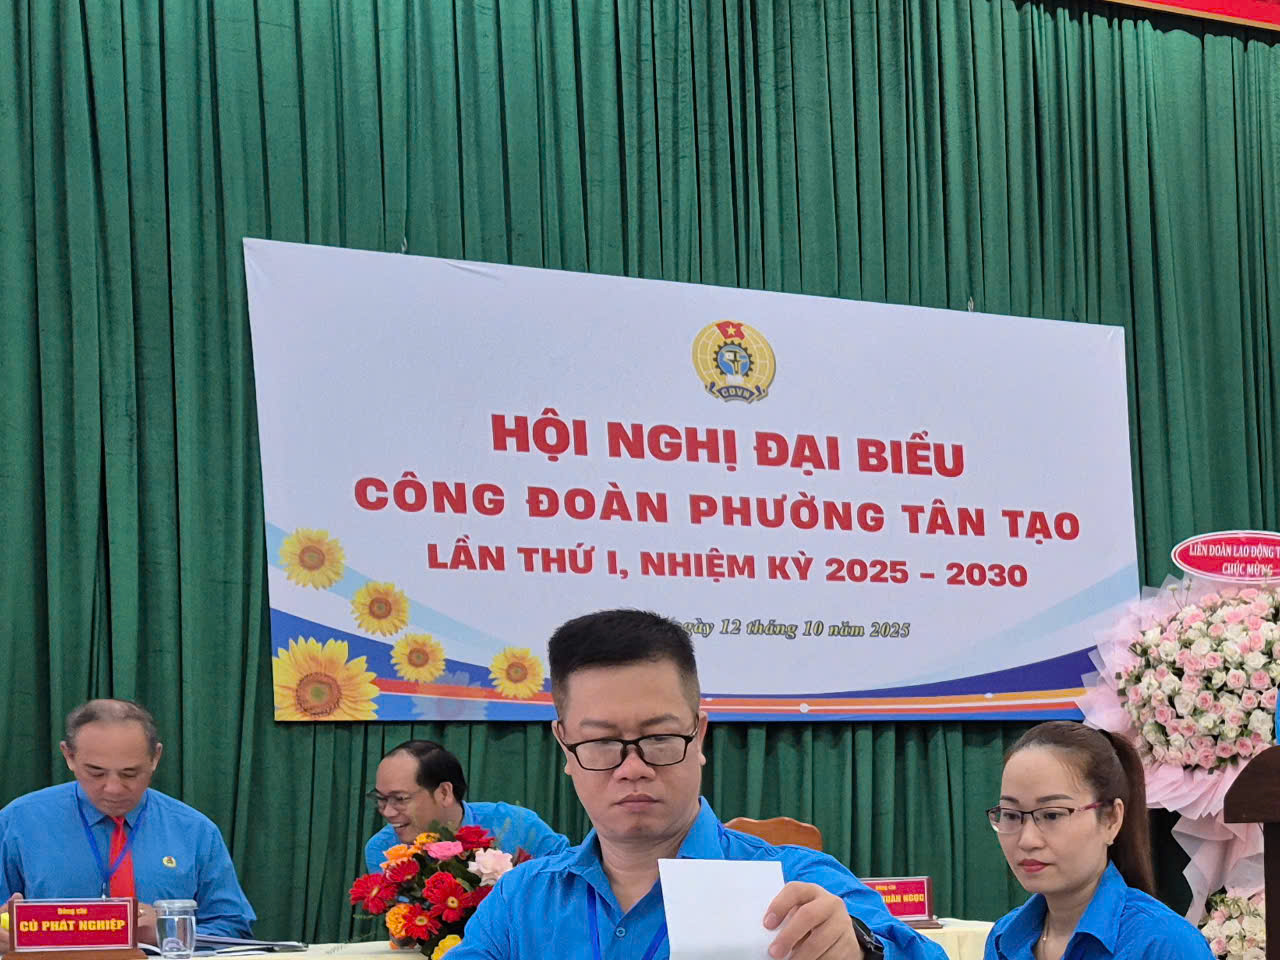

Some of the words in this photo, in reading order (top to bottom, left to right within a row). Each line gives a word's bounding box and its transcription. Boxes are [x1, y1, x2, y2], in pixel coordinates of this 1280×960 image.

[491, 408, 588, 462] HỘI
[607, 422, 737, 472] NGHỊ
[754, 431, 840, 476] ĐẠI
[857, 431, 965, 477] BIỂU
[354, 471, 505, 516] CÔNG
[526, 482, 668, 523] ĐOÀN
[689, 491, 885, 533] PHƯỜNG
[901, 498, 986, 537] TÂN
[1001, 509, 1080, 545] TẠO
[427, 534, 505, 571] LẦN
[517, 542, 596, 574] THỨ
[607, 550, 629, 580] I,
[640, 547, 756, 583] NHIỆM
[767, 550, 814, 581] KỲ
[825, 558, 909, 584] 2025
[946, 562, 1028, 588] 2030
[675, 617, 715, 638] gày
[720, 618, 743, 635] 12
[746, 619, 798, 640] tháng
[802, 620, 824, 637] 10
[828, 621, 865, 638] năm
[870, 622, 910, 638] 2025
